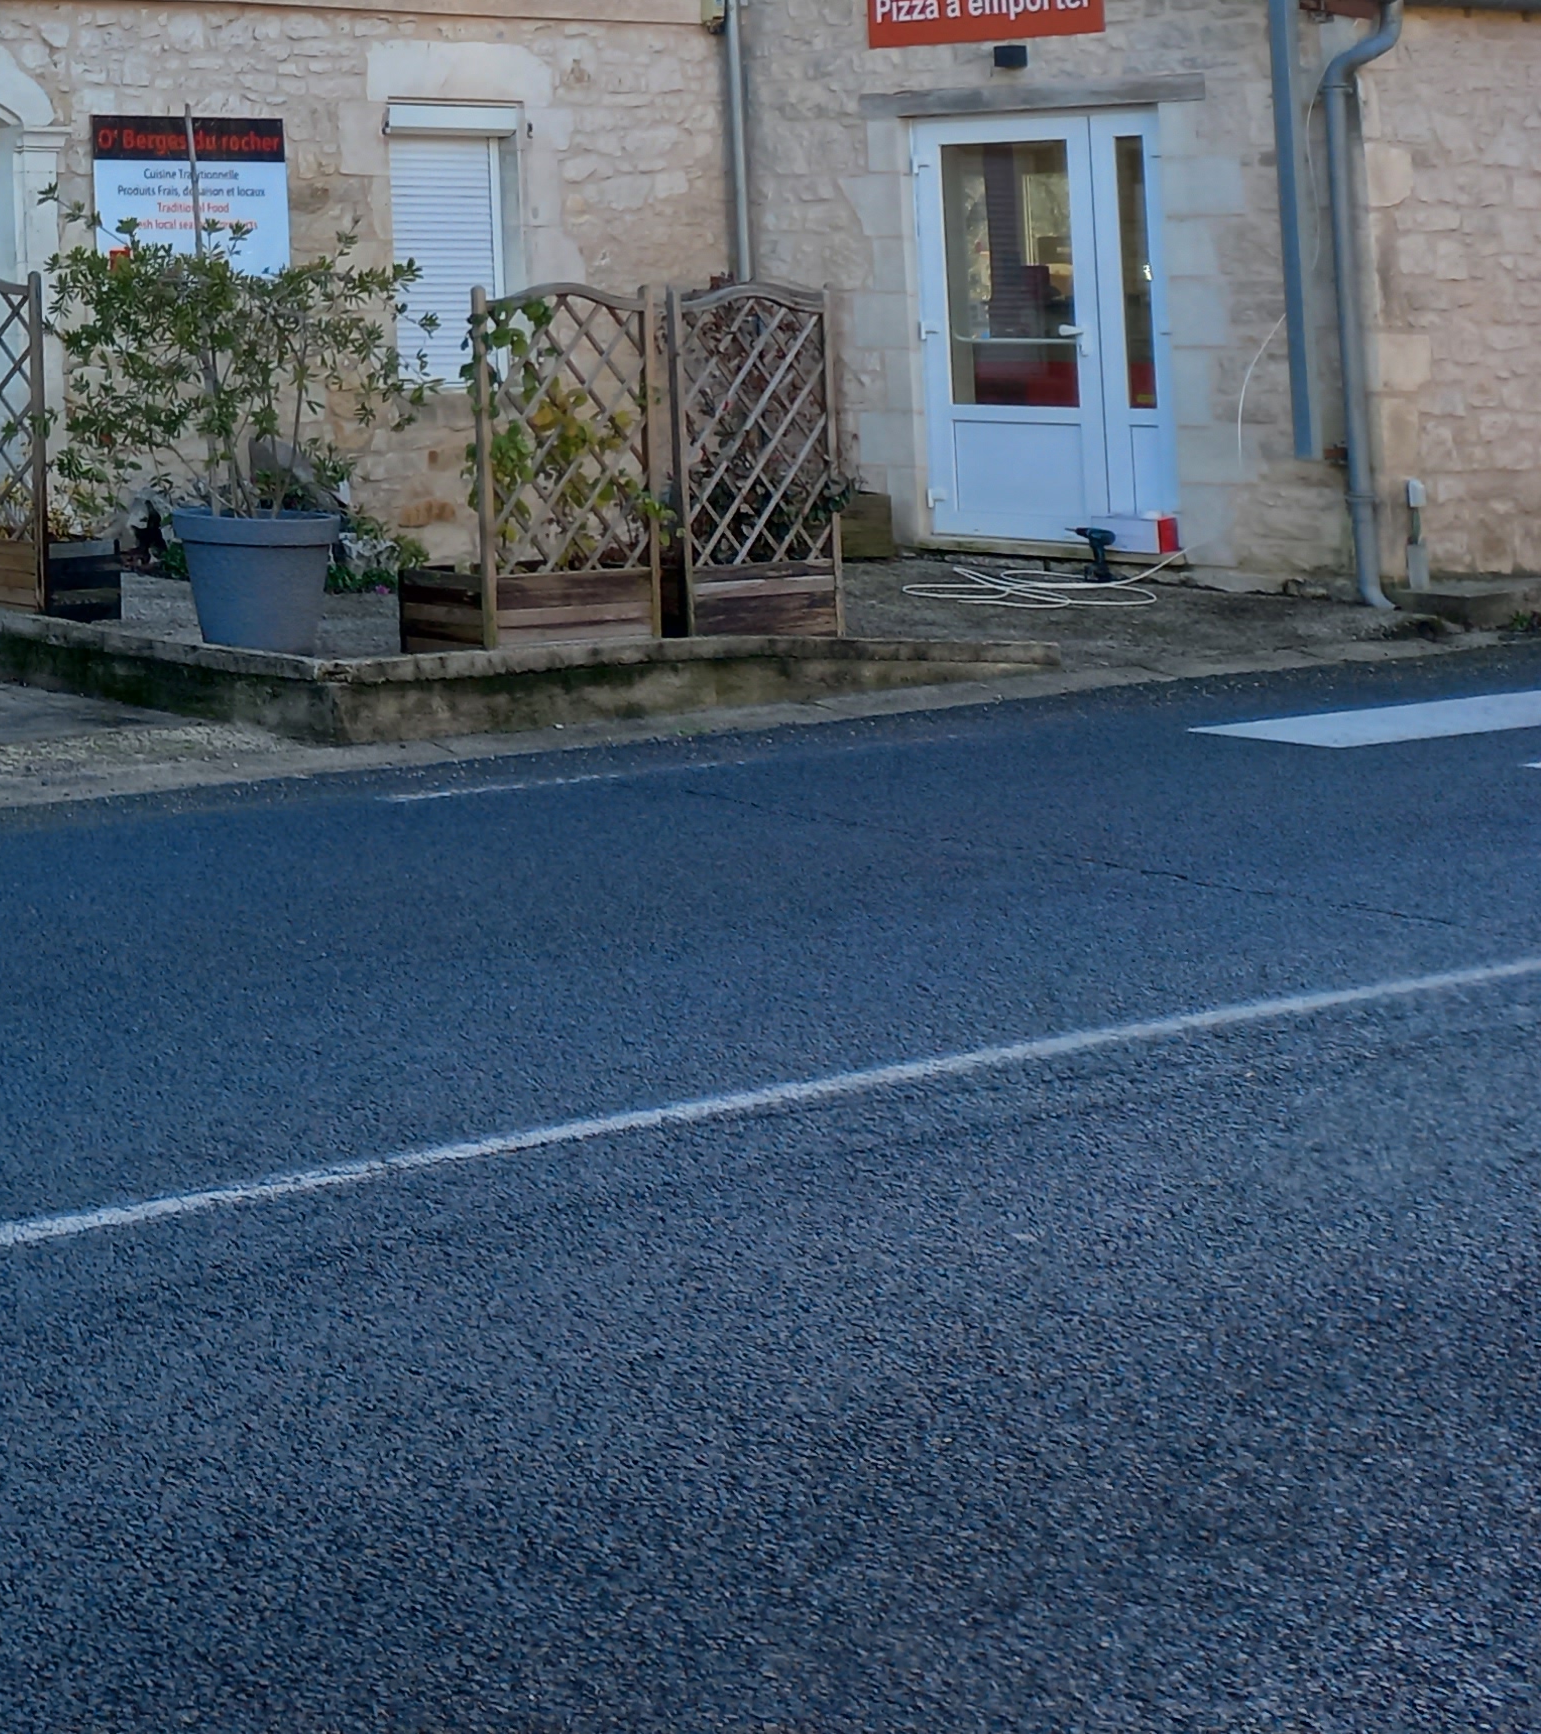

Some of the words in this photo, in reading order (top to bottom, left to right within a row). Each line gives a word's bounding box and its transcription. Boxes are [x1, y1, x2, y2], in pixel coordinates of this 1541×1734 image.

[122, 129, 187, 155] Berges
[194, 130, 217, 151] du
[221, 131, 280, 151] rocher
[143, 168, 176, 180] Cuisine
[118, 185, 156, 196] Produits
[157, 185, 181, 197] Frais,
[226, 187, 235, 196] et
[237, 185, 265, 197] locaux
[207, 202, 230, 212] Food
[155, 219, 176, 230] local
